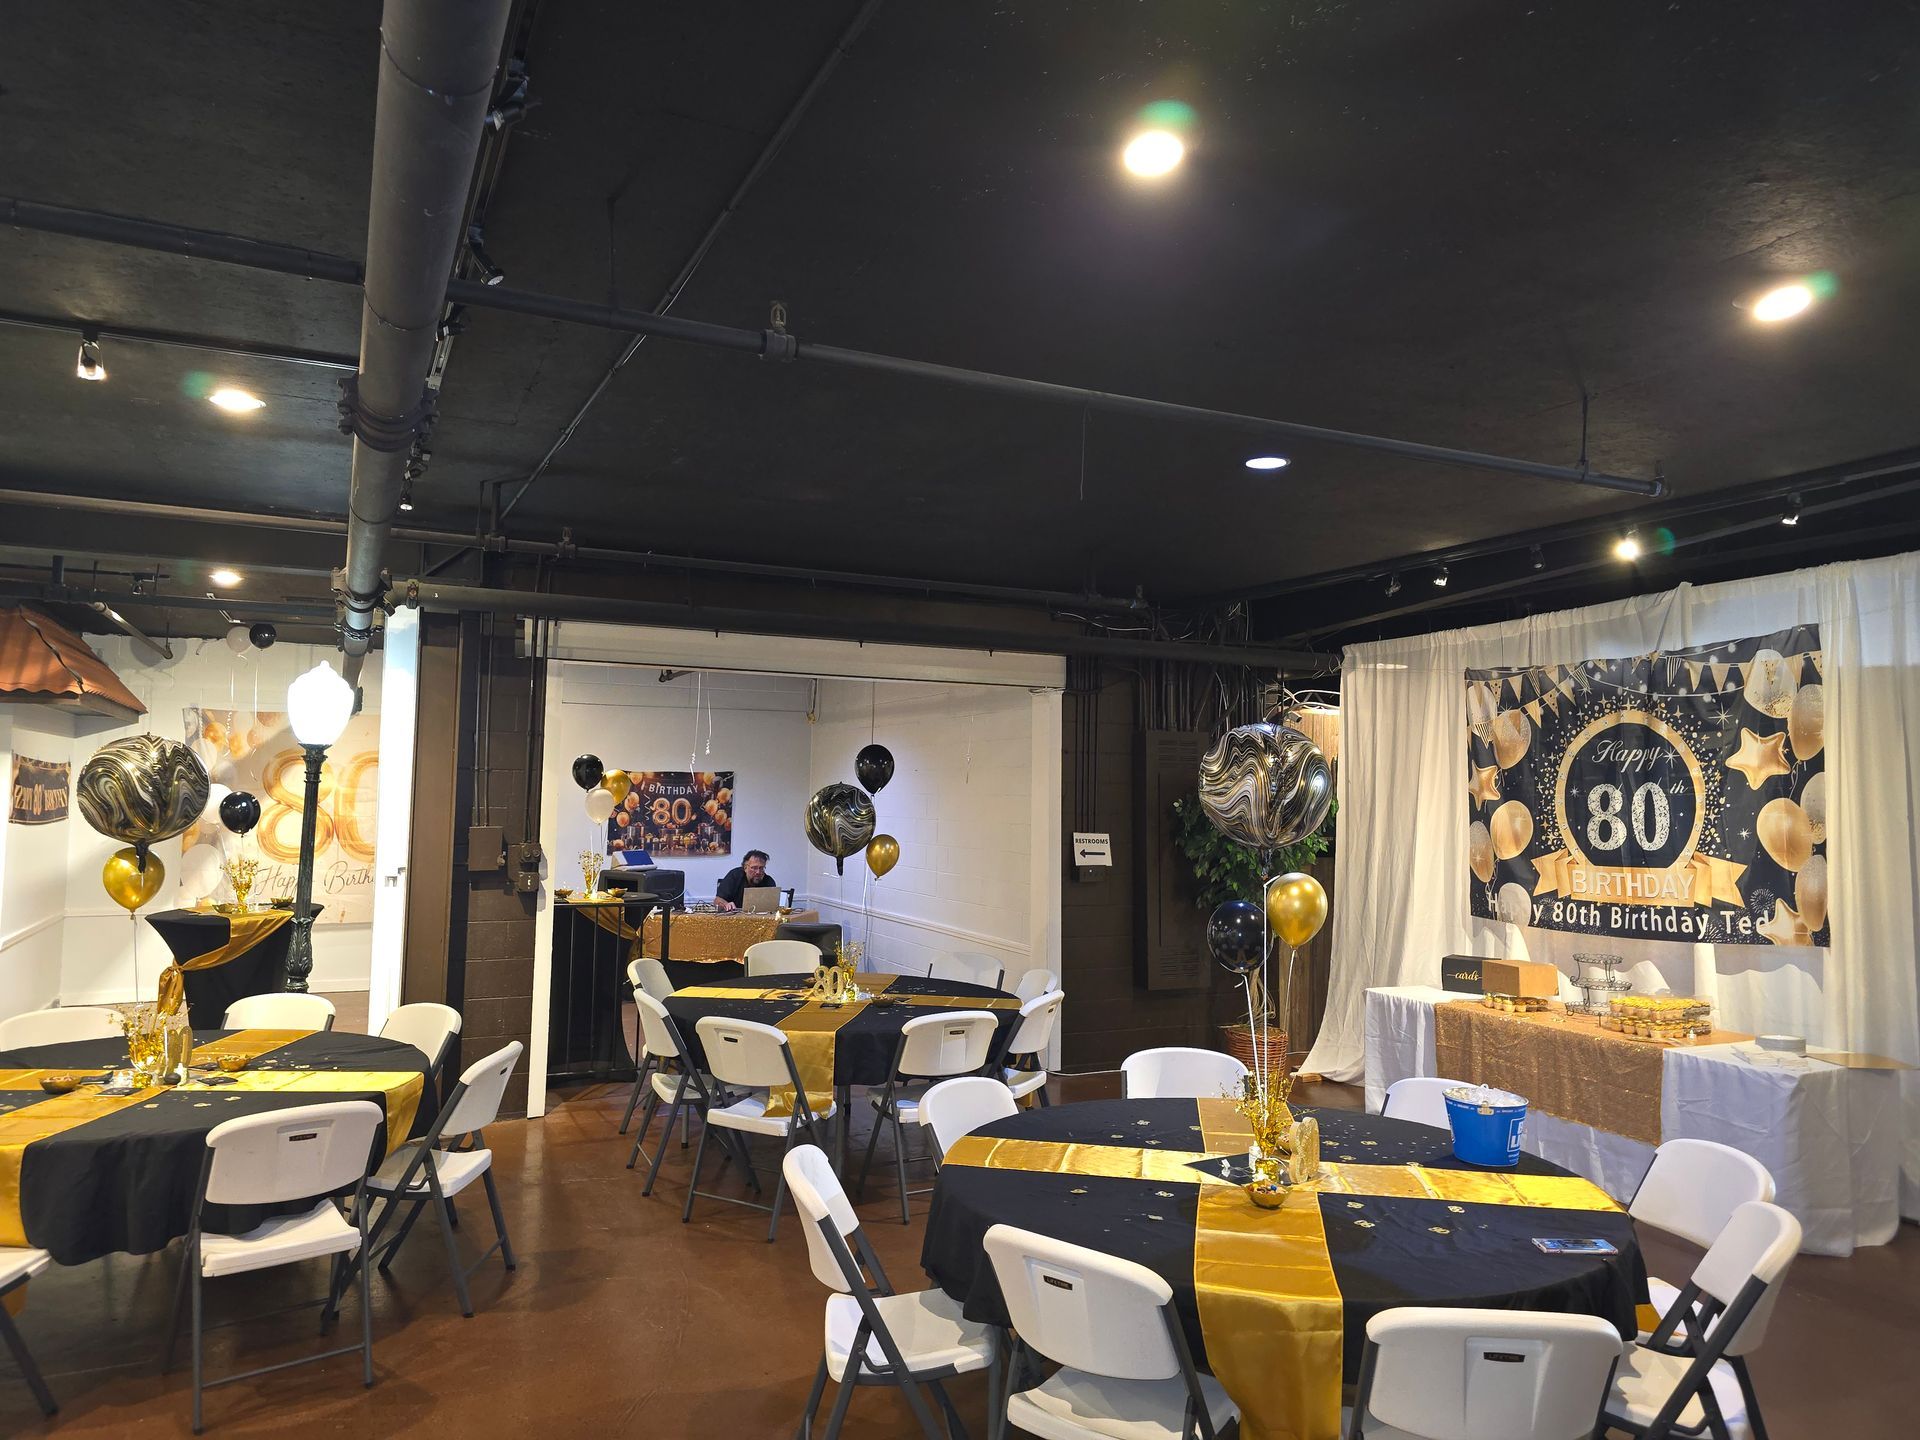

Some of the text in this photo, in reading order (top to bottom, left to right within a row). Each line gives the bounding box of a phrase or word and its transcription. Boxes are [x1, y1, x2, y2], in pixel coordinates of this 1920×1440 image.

[1592, 739, 1664, 772] Happy
[649, 783, 698, 795] BIRTHDAY
[652, 797, 692, 825] 80
[254, 864, 299, 897] Happ
[1572, 869, 1694, 899] BIRTHDAY
[1553, 902, 1600, 926] 80th
[1611, 906, 1709, 939] Birthday
[1720, 910, 1768, 935] Ted
